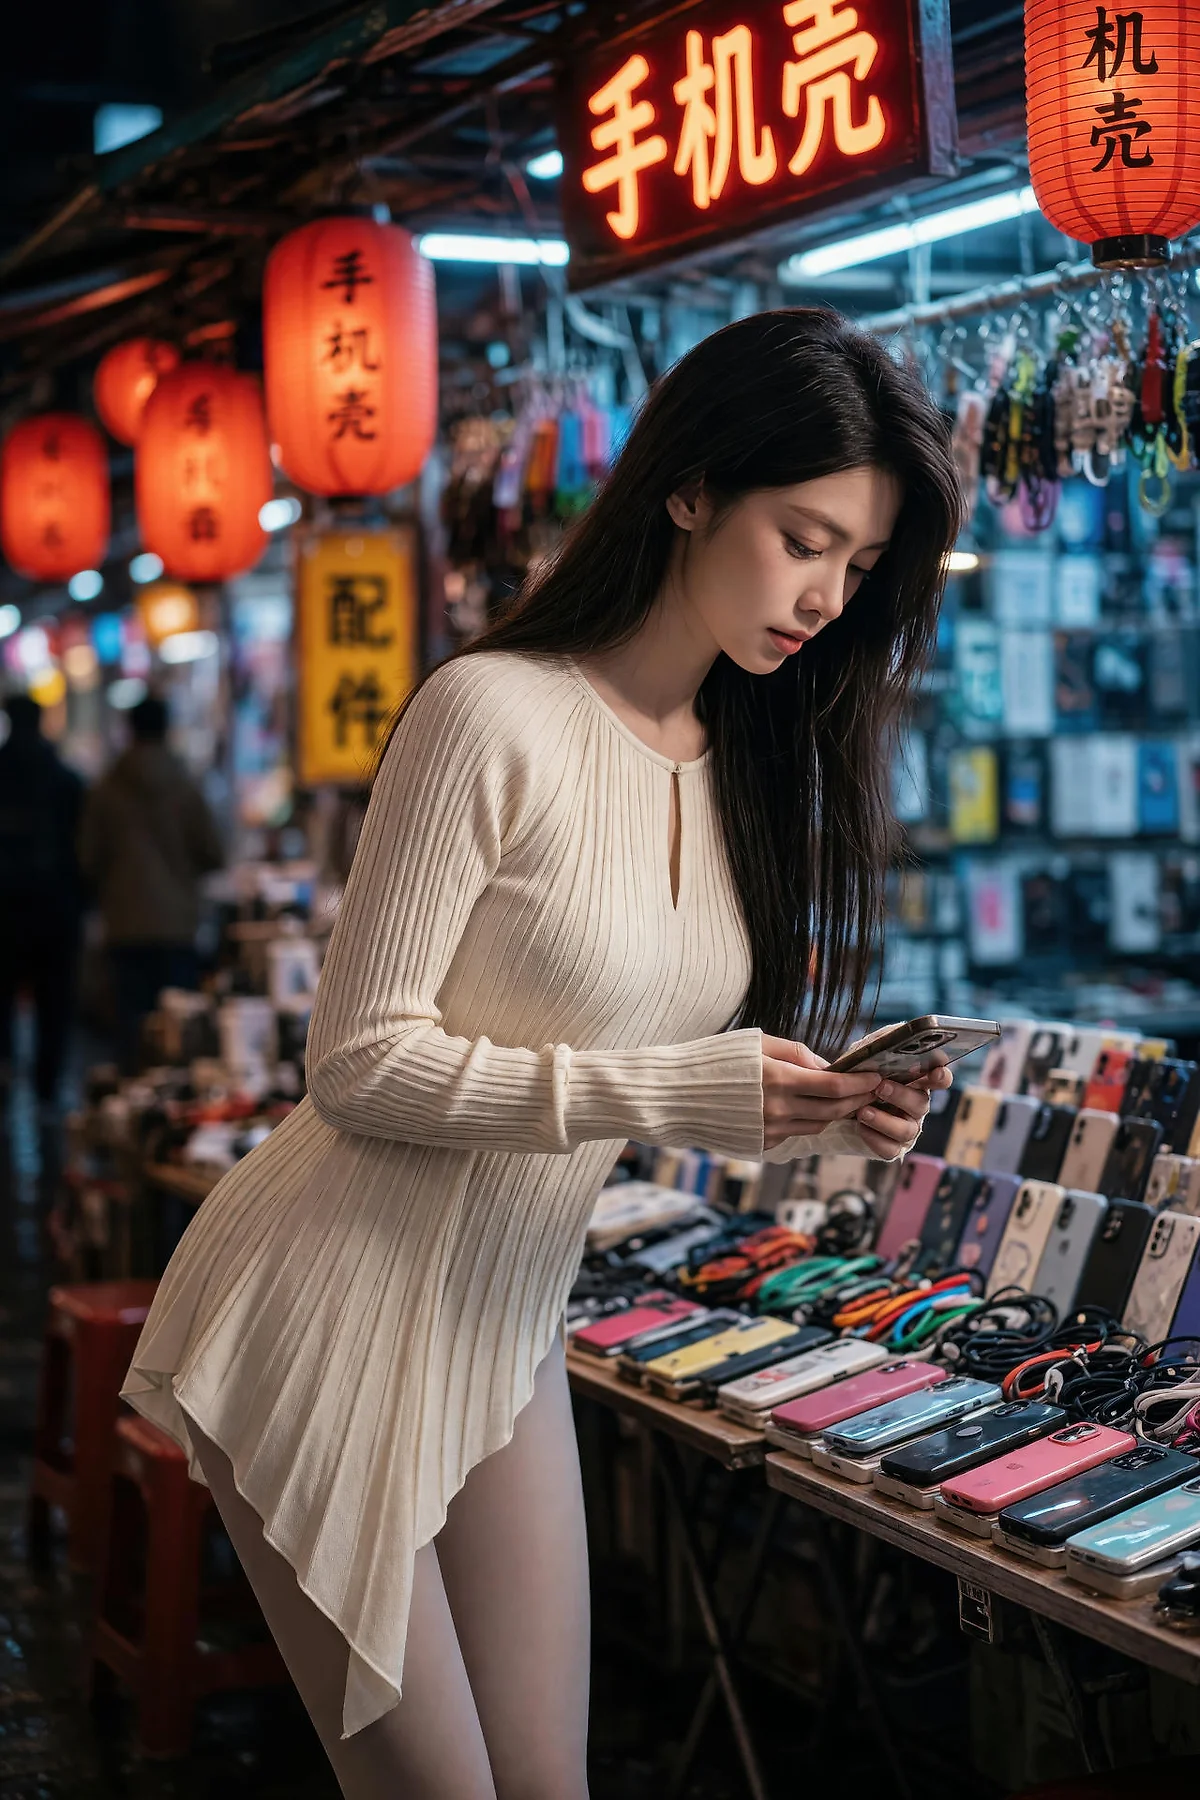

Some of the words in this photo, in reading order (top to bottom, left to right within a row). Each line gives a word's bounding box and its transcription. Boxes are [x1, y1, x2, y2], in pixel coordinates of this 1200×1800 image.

[583, 0, 885, 239] 手机壳
[328, 572, 396, 749] 配件
